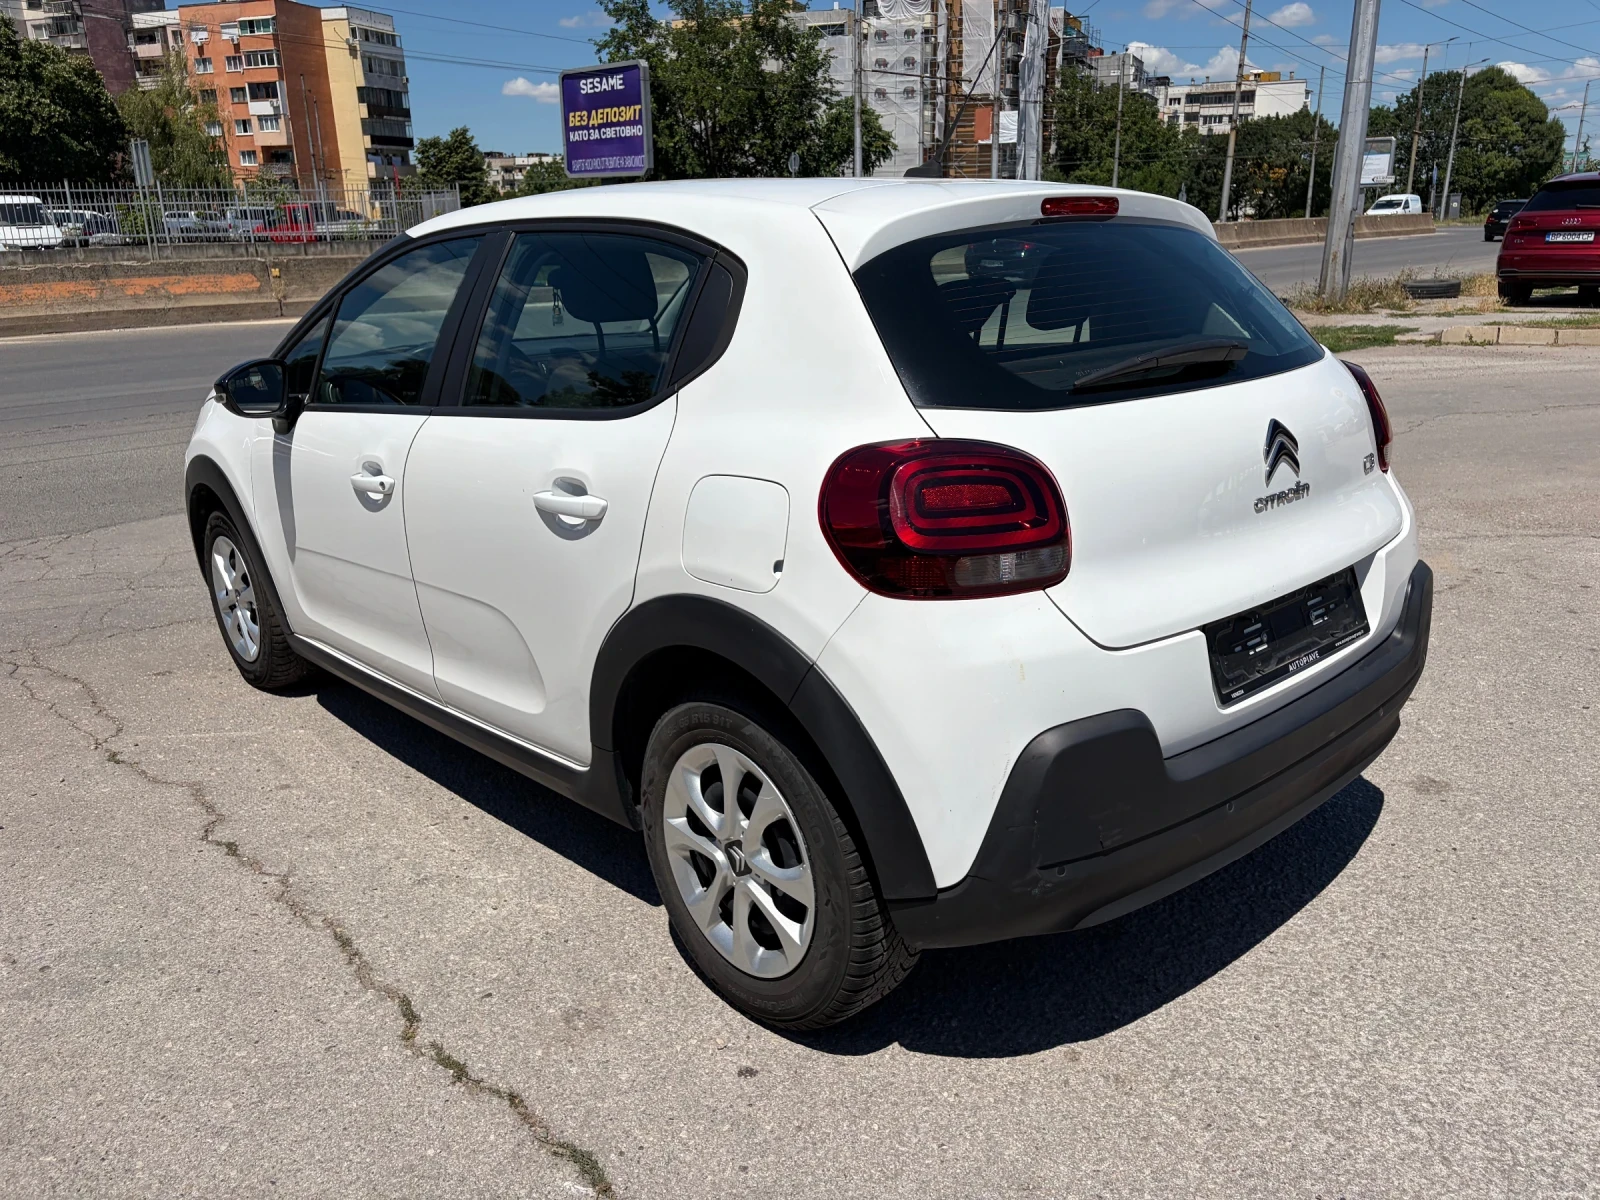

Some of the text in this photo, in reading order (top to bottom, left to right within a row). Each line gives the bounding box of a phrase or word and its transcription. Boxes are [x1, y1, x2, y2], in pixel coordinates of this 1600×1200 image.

[580, 74, 625, 94] SESAME
[569, 105, 641, 128] БЕЗ ДЕПОЗИТ
[569, 125, 643, 142] КАТО ЗА СВЕТОВНО
[1288, 650, 1320, 672] AUTOPIAVE
